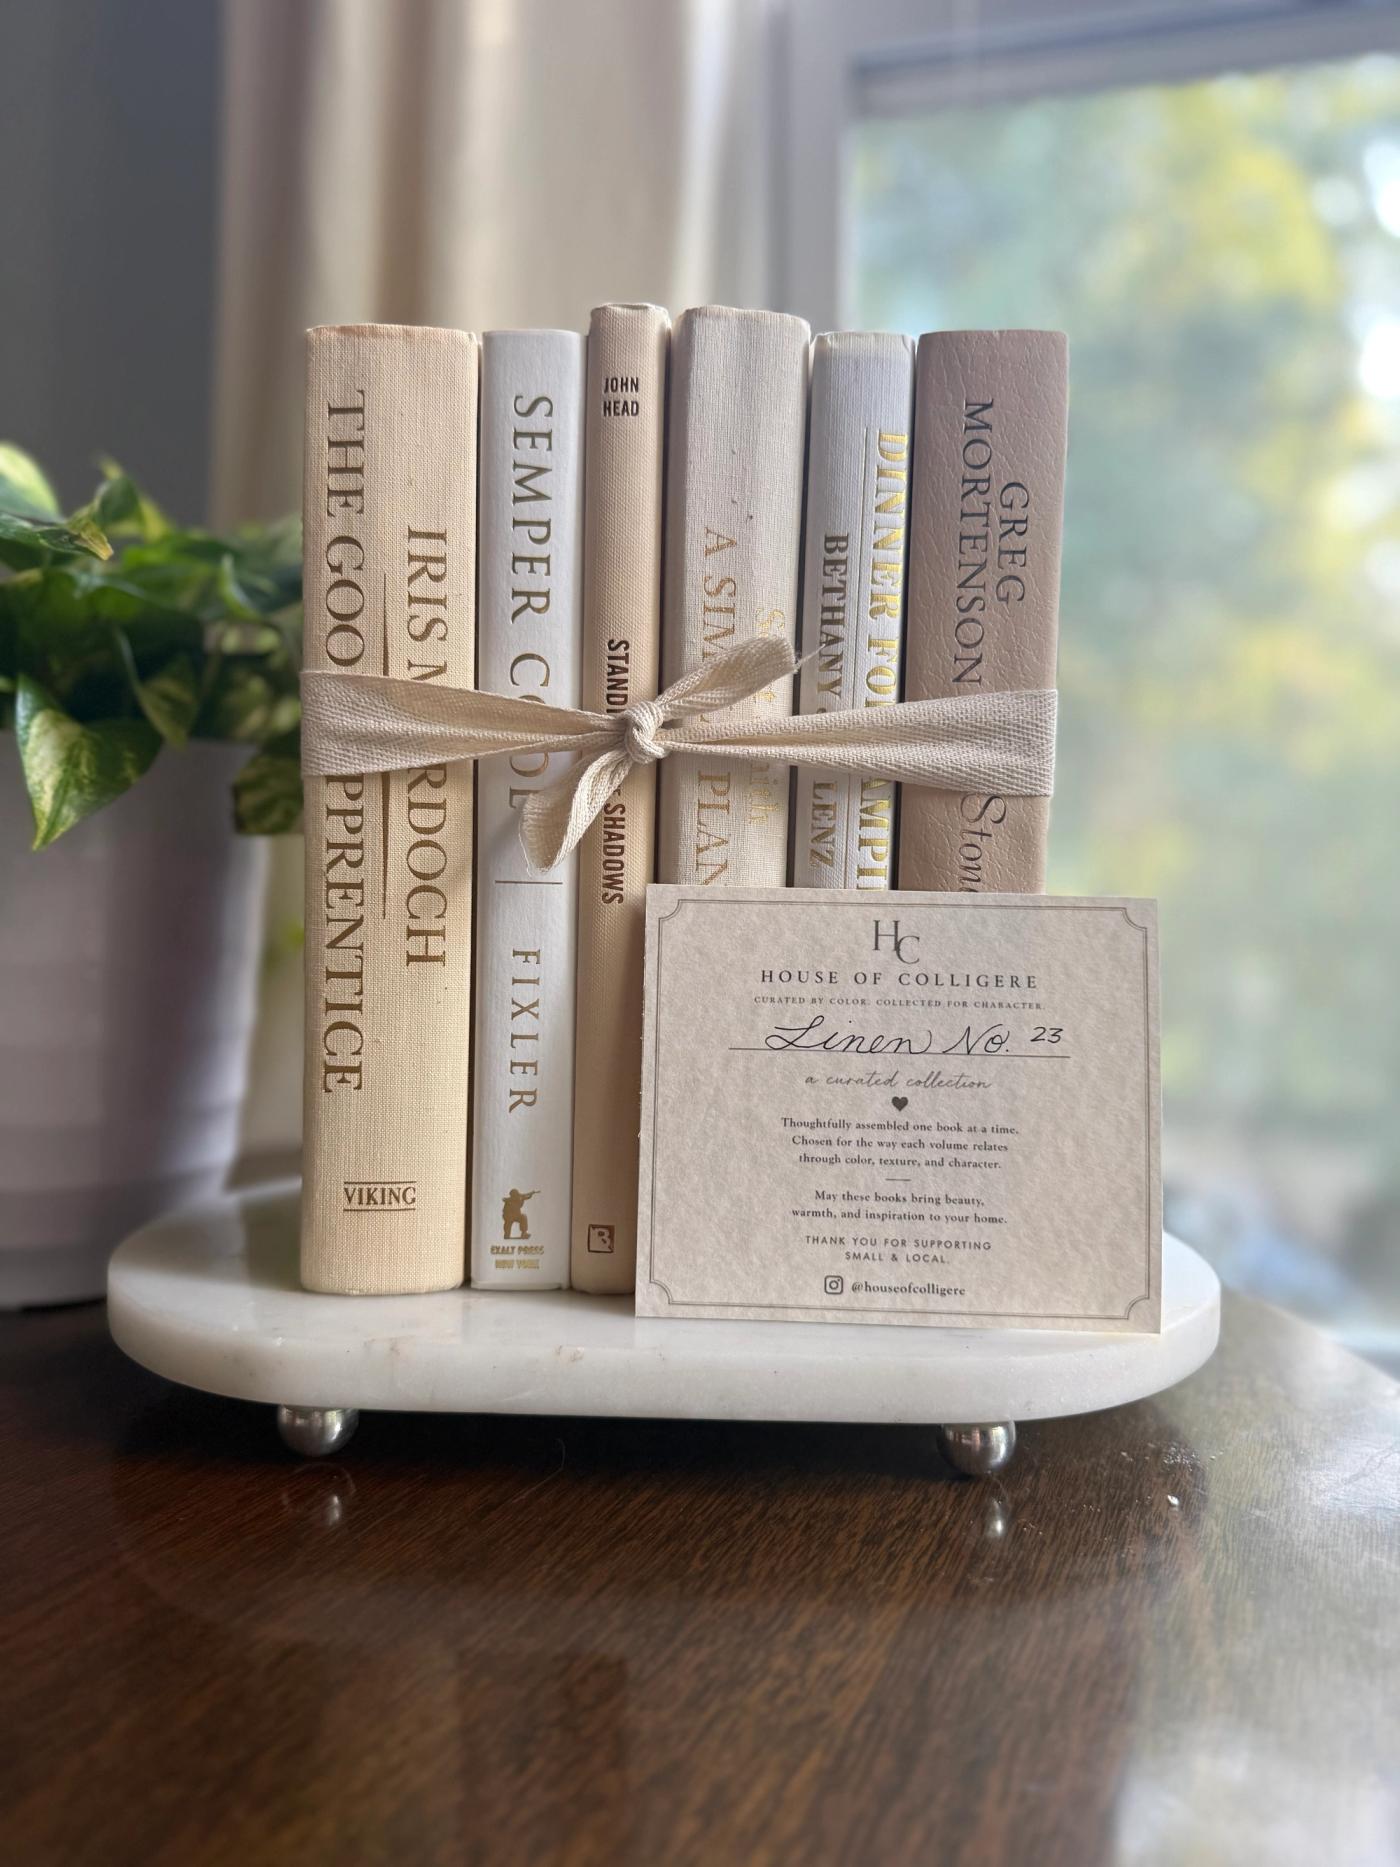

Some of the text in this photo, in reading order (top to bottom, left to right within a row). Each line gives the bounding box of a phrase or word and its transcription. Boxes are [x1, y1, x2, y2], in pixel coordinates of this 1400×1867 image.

[604, 376, 639, 393] JOHN
[603, 400, 639, 417] HEAD
[867, 431, 909, 620] DINNER
[704, 526, 737, 557] A
[953, 398, 994, 686] MORTENSON
[995, 482, 1031, 604] GREG
[508, 395, 554, 809] SEMPER COL
[809, 533, 850, 869] BETHANY LENZ
[322, 390, 365, 1094] THE GOO PPRENTICE
[406, 525, 448, 968] IRIS RDOCH
[602, 639, 630, 905] STANDI SHADOWS
[958, 793, 1007, 892] Ston
[761, 970, 1037, 989] HOUSE OF COLLIGERE
[754, 996, 805, 1004] CURATED
[508, 949, 541, 1114] FIXLER
[764, 1015, 1064, 1055] Linen No. 23
[805, 1070, 992, 1090] a curated collection
[781, 1117, 852, 1131] Thoughtfully
[855, 1120, 909, 1132] assembled
[913, 1124, 933, 1132] one
[937, 1122, 963, 1134] book
[967, 1126, 978, 1134] at
[991, 1124, 1019, 1136] time.
[792, 1135, 1008, 1152] Chosen for the way each volume relates
[799, 1153, 1002, 1170] through color, texture, and character.
[343, 1186, 416, 1206] VIKING
[815, 1190, 985, 1208] May these books bring beauty,
[792, 1207, 1008, 1225] warmth, and inspiration to your home.
[491, 1245, 545, 1255] EXALT PRESS
[805, 1235, 993, 1251] THANK YOU FOR SUPPORTING
[845, 1251, 884, 1262] SMALL
[891, 1252, 899, 1262] &
[851, 1280, 966, 1297] @houseofcolligere
